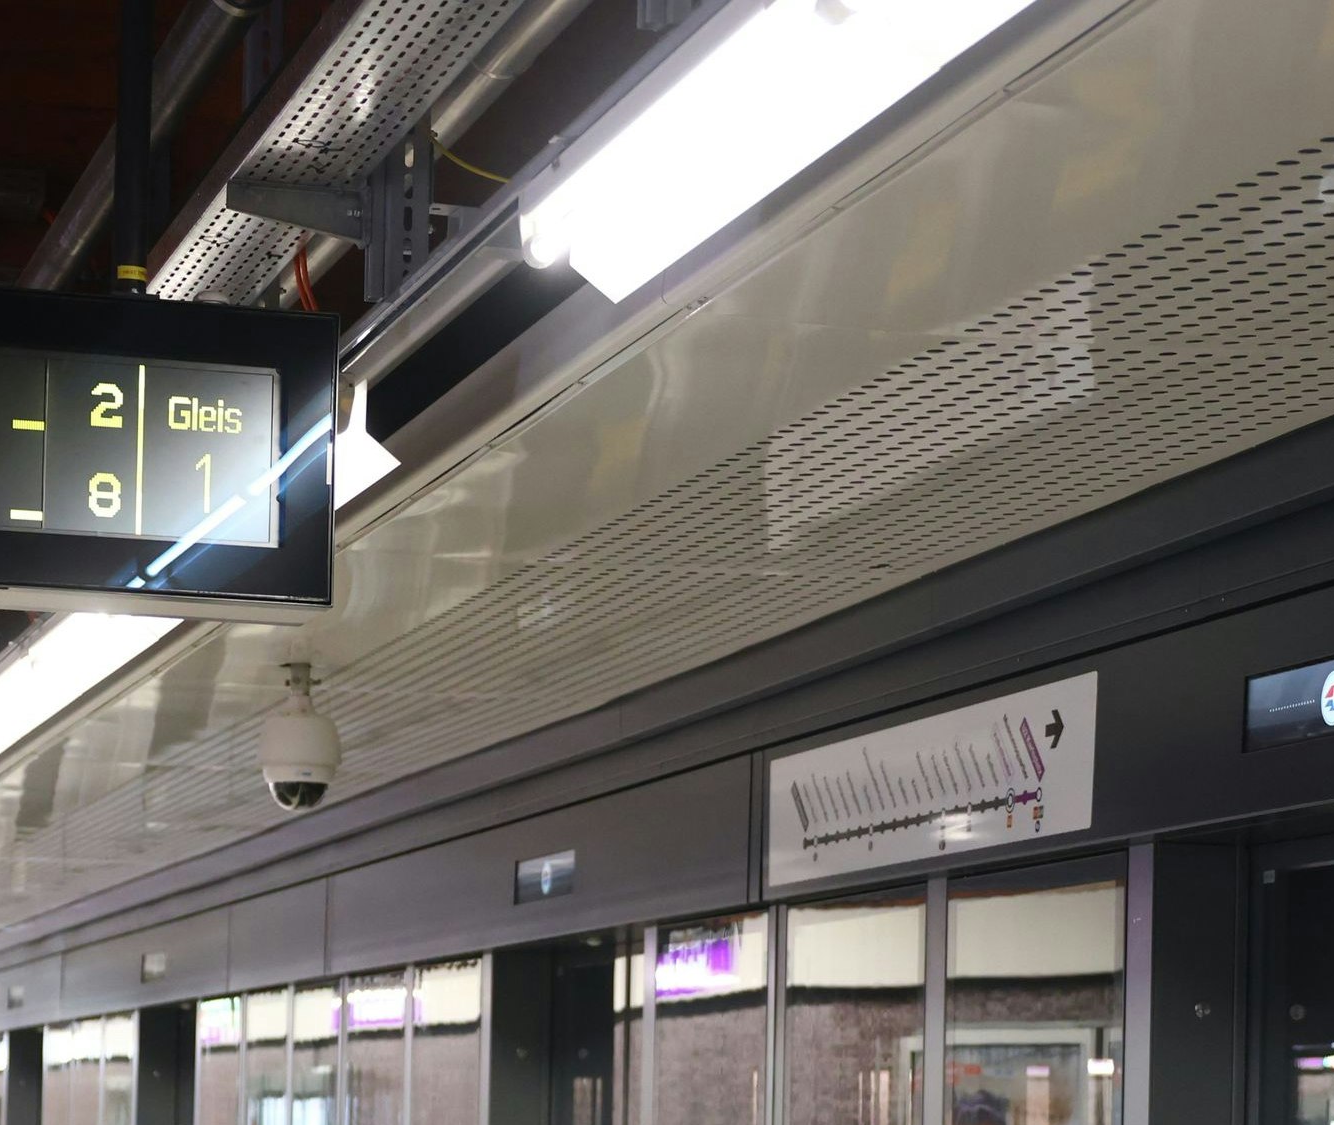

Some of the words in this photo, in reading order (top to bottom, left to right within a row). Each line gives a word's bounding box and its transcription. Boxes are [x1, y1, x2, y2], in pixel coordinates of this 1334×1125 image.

[90, 382, 123, 428] 2
[168, 395, 242, 434] Gleis
[88, 472, 121, 518] 8
[195, 453, 212, 514] 1
